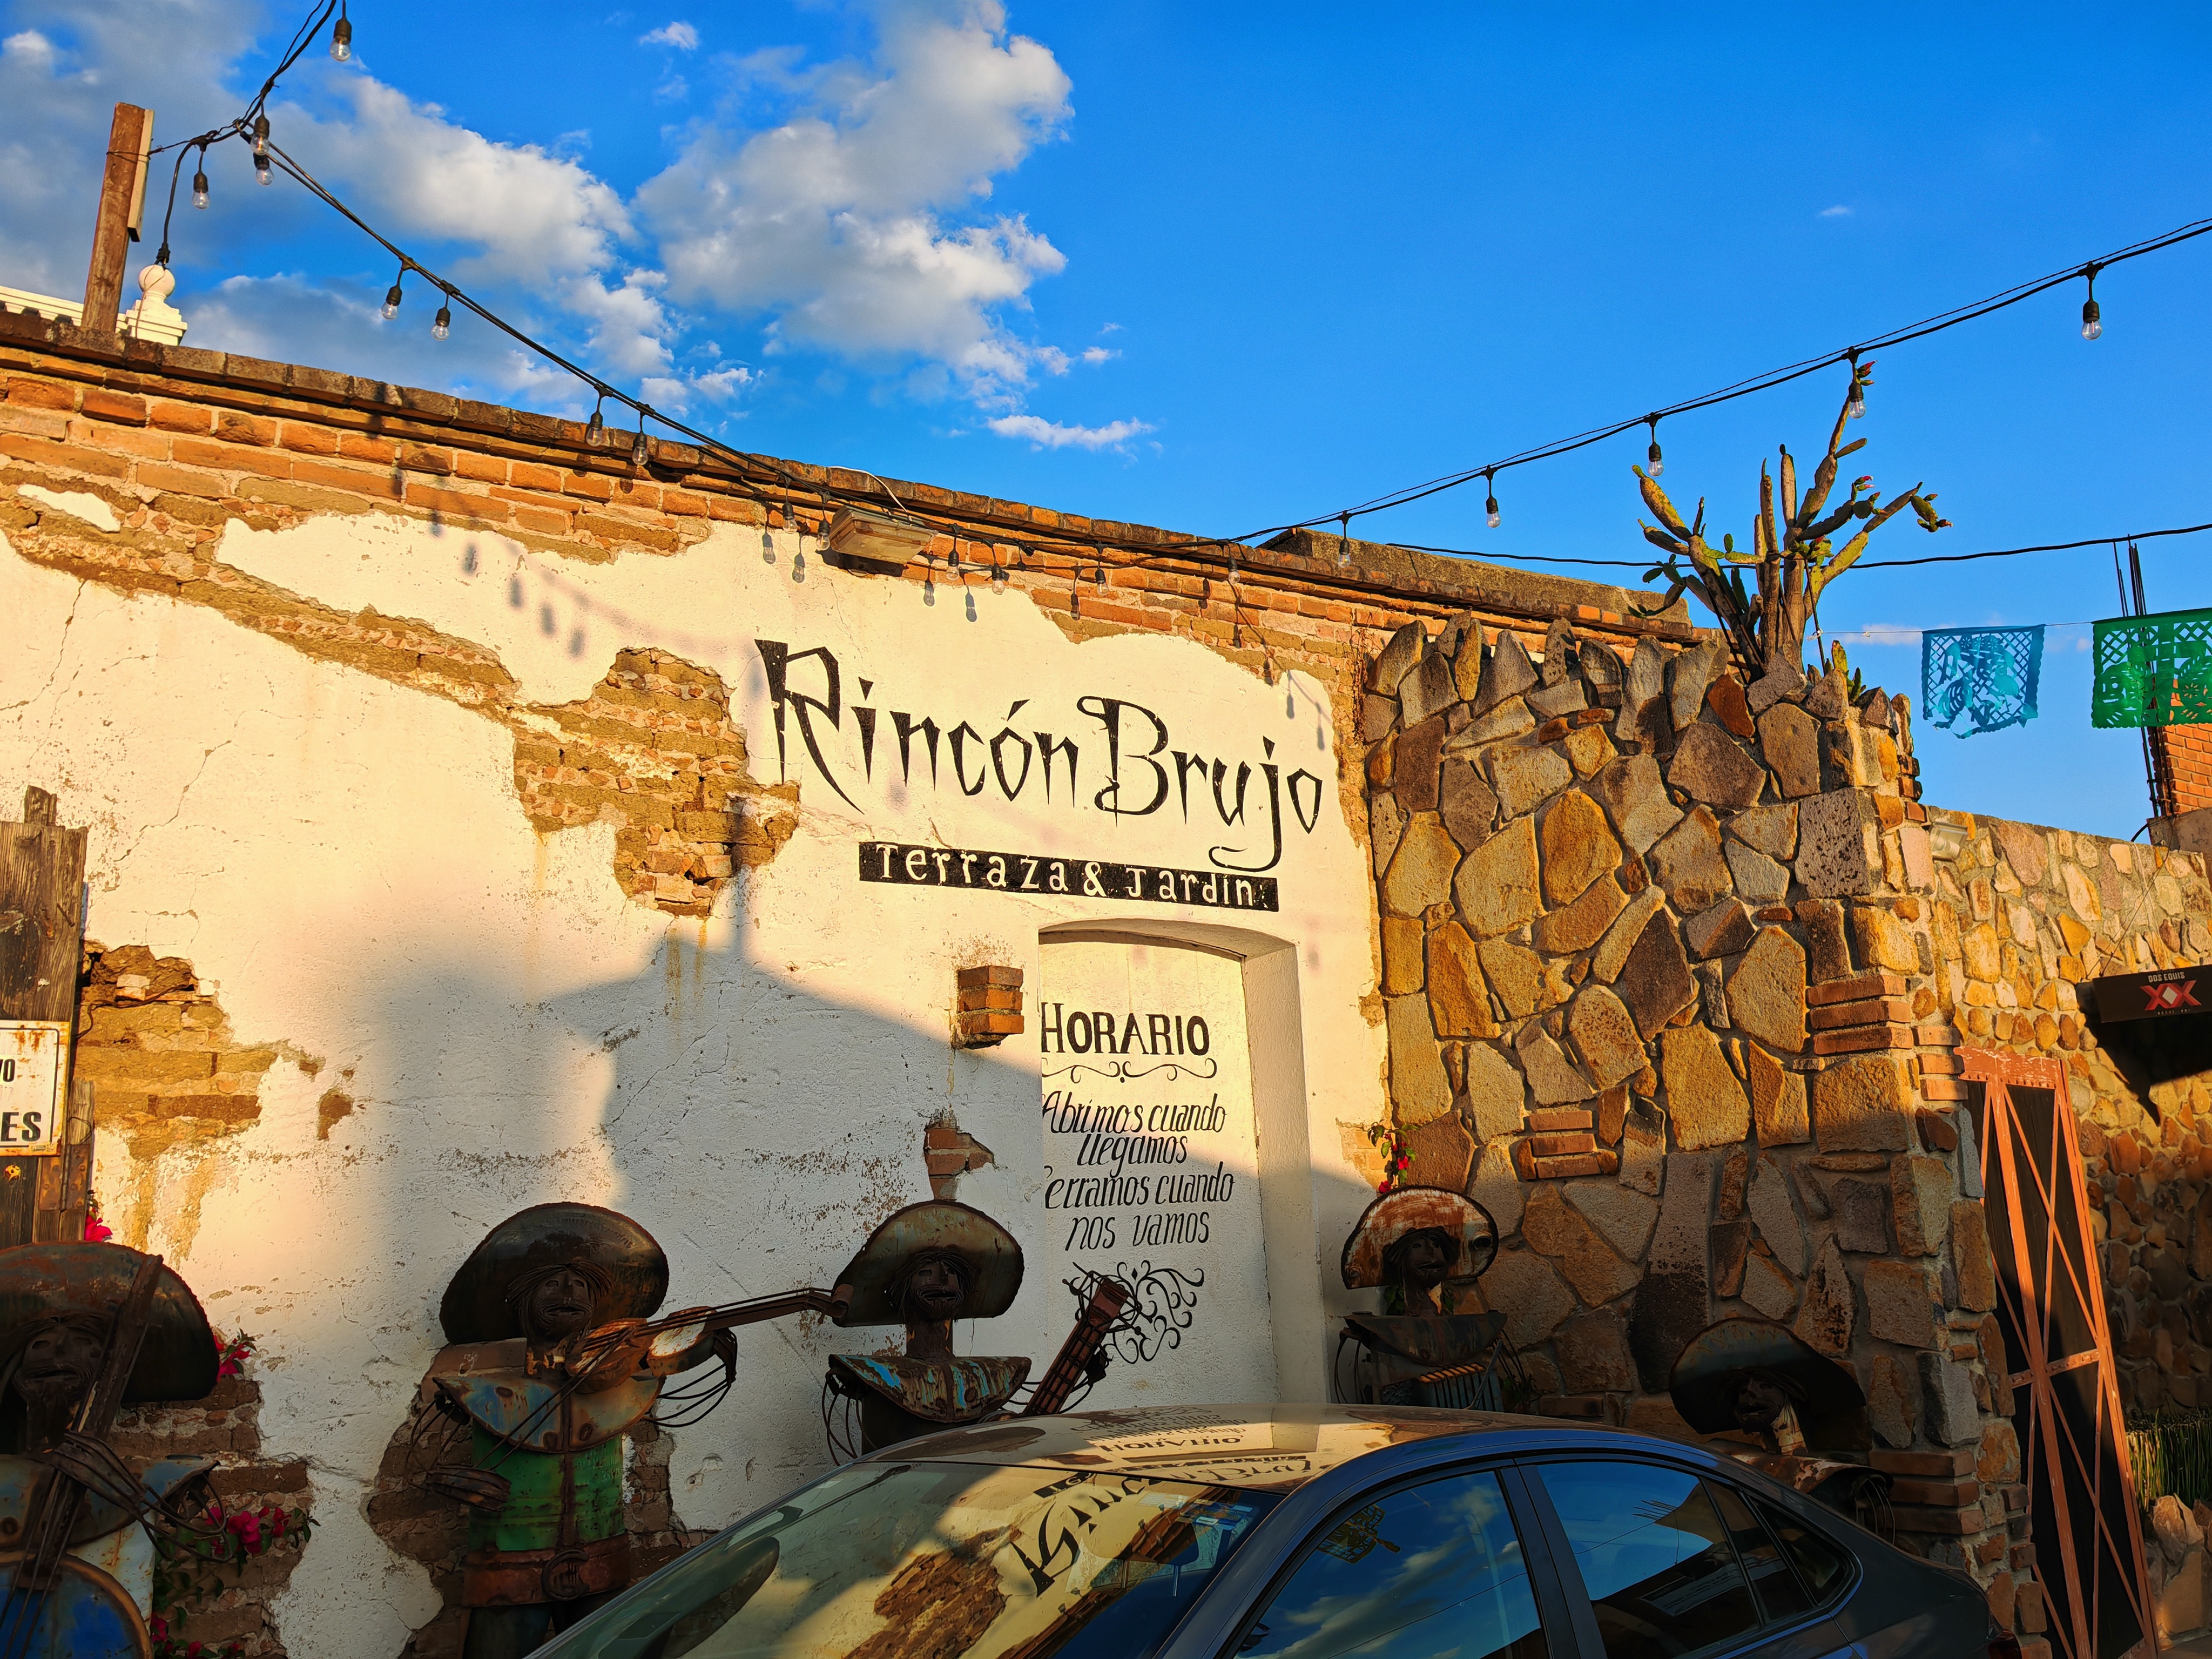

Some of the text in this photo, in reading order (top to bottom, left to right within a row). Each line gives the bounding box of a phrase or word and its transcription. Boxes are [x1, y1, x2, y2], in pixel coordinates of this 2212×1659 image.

[753, 639, 1323, 873] Rincón Brujo
[875, 843, 1069, 892] Terraza
[1083, 861, 1107, 898] &
[2139, 980, 2202, 1011] XX
[2148, 971, 2186, 983] DOS EQUIS
[1041, 1002, 1210, 1056] HORARIO
[0, 1058, 16, 1082] O
[0, 1111, 42, 1142] ES
[1042, 1090, 1229, 1134] Abrimos cuando
[1076, 1134, 1188, 1178] llegamos
[1155, 1161, 1235, 1206] cuando
[1064, 1211, 1210, 1251] nos vamos
